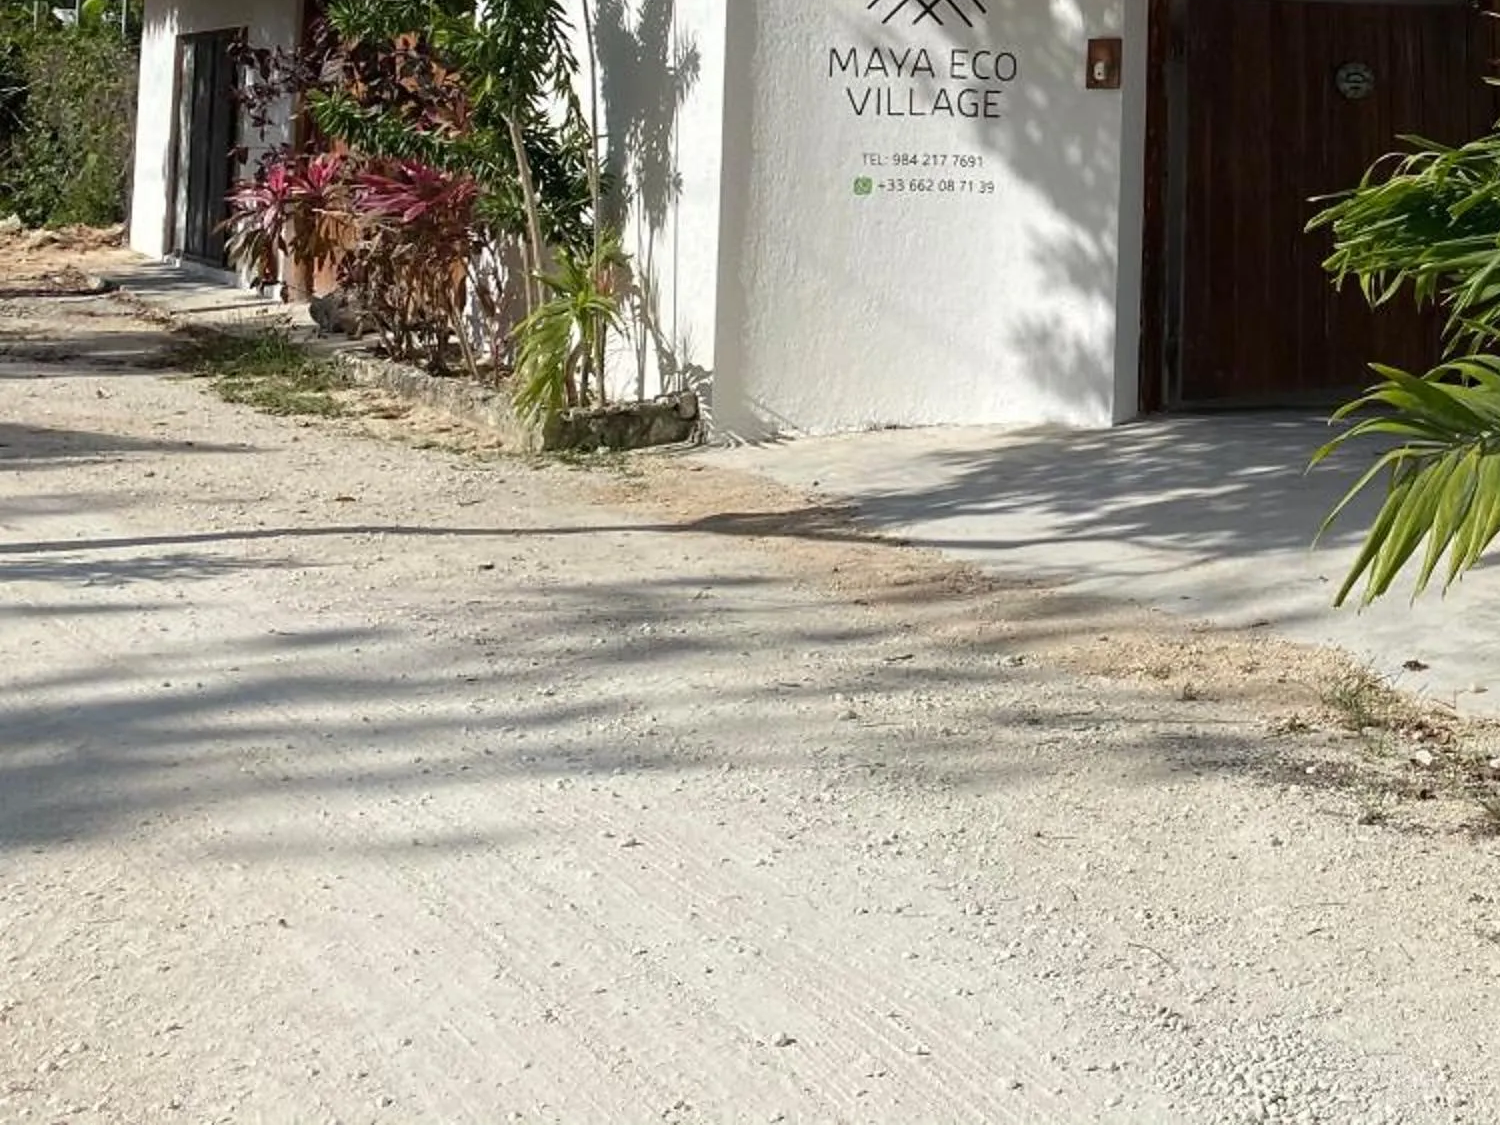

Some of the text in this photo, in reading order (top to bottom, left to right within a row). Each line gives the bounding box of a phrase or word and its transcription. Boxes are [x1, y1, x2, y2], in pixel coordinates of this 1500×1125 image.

[828, 47, 1018, 82] MAYA ECO
[846, 86, 1003, 118] VILLAGE
[892, 152, 918, 166] 984
[922, 153, 948, 166] 217
[952, 154, 983, 168] 7691
[909, 178, 934, 192] 662
[937, 178, 955, 192] 08
[959, 179, 973, 193] 71
